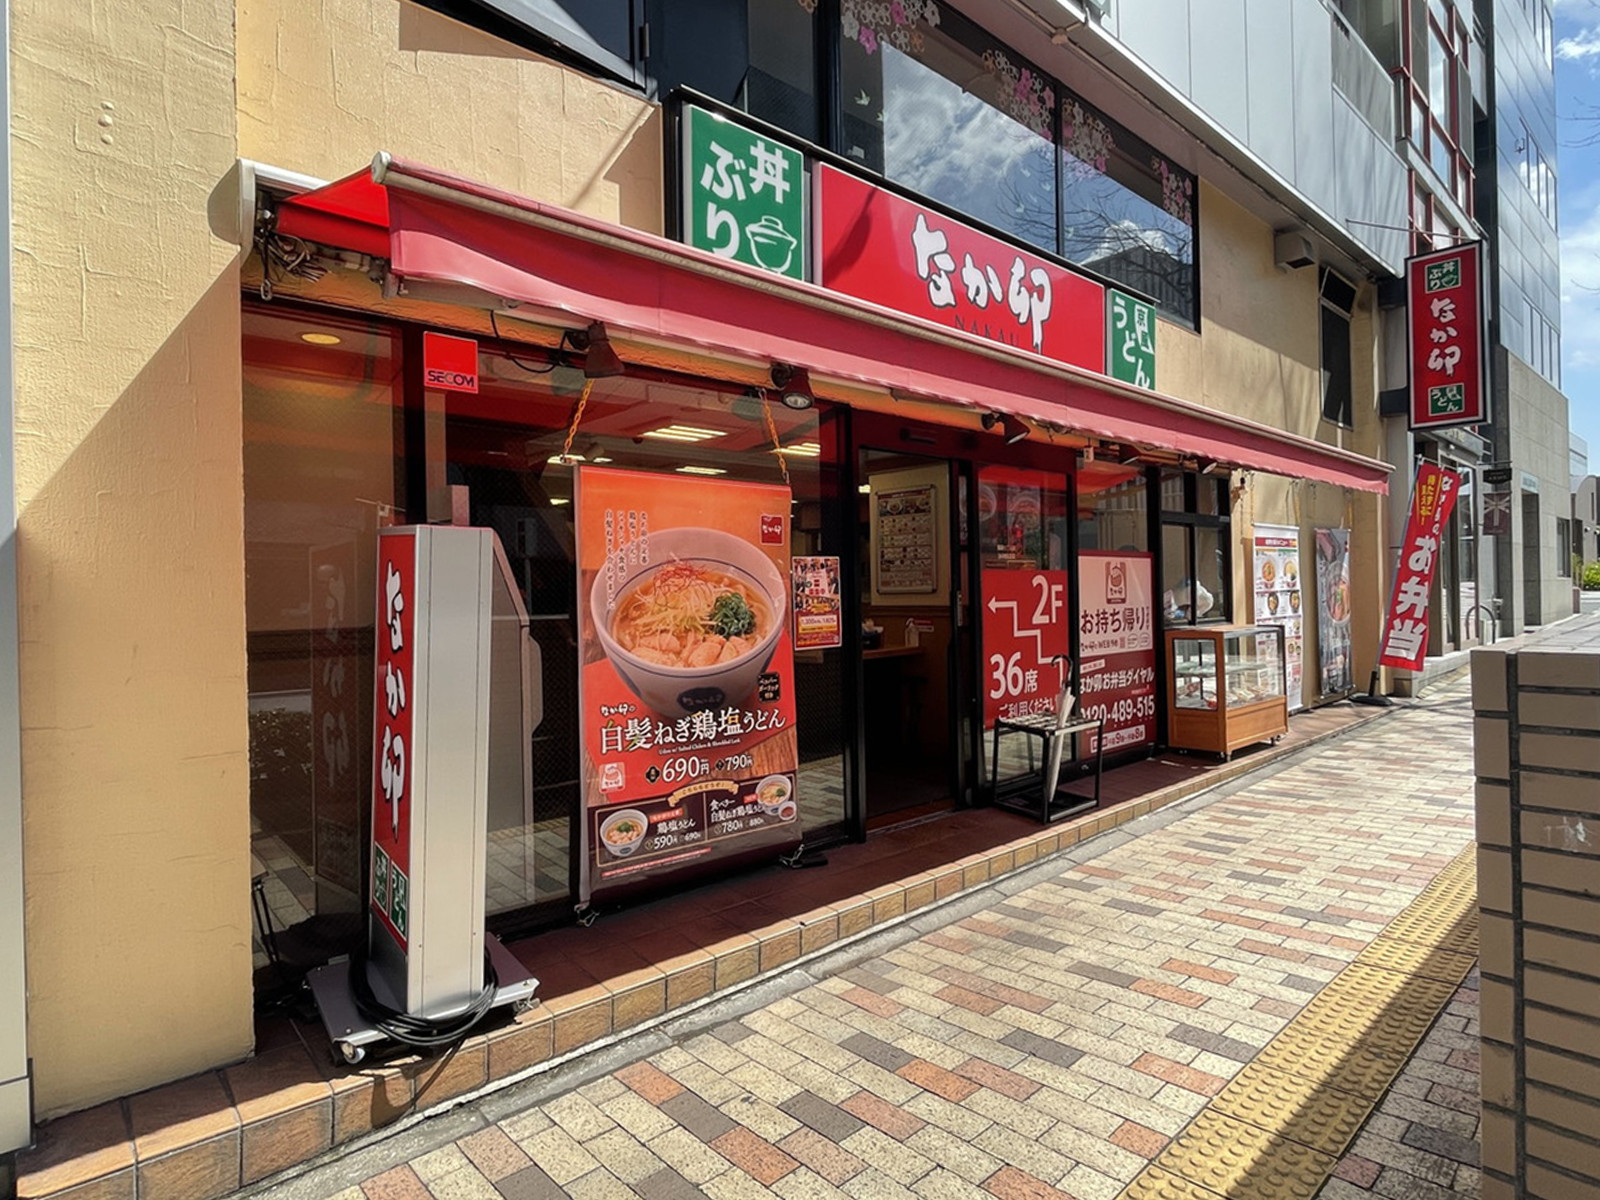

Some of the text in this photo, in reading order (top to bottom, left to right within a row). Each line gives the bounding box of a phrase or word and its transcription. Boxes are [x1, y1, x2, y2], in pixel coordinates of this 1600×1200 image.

[911, 212, 1053, 355] なか卯
[1427, 298, 1461, 377] なか卯
[428, 370, 475, 388] SECOM
[1032, 574, 1063, 625] 2F
[1080, 606, 1145, 635] お持ち帰り
[1384, 535, 1437, 661] お弁当
[990, 652, 1038, 699] 36席
[380, 560, 406, 843] なか卯
[601, 706, 786, 754] 白髪ねぎ鶏塩うどん
